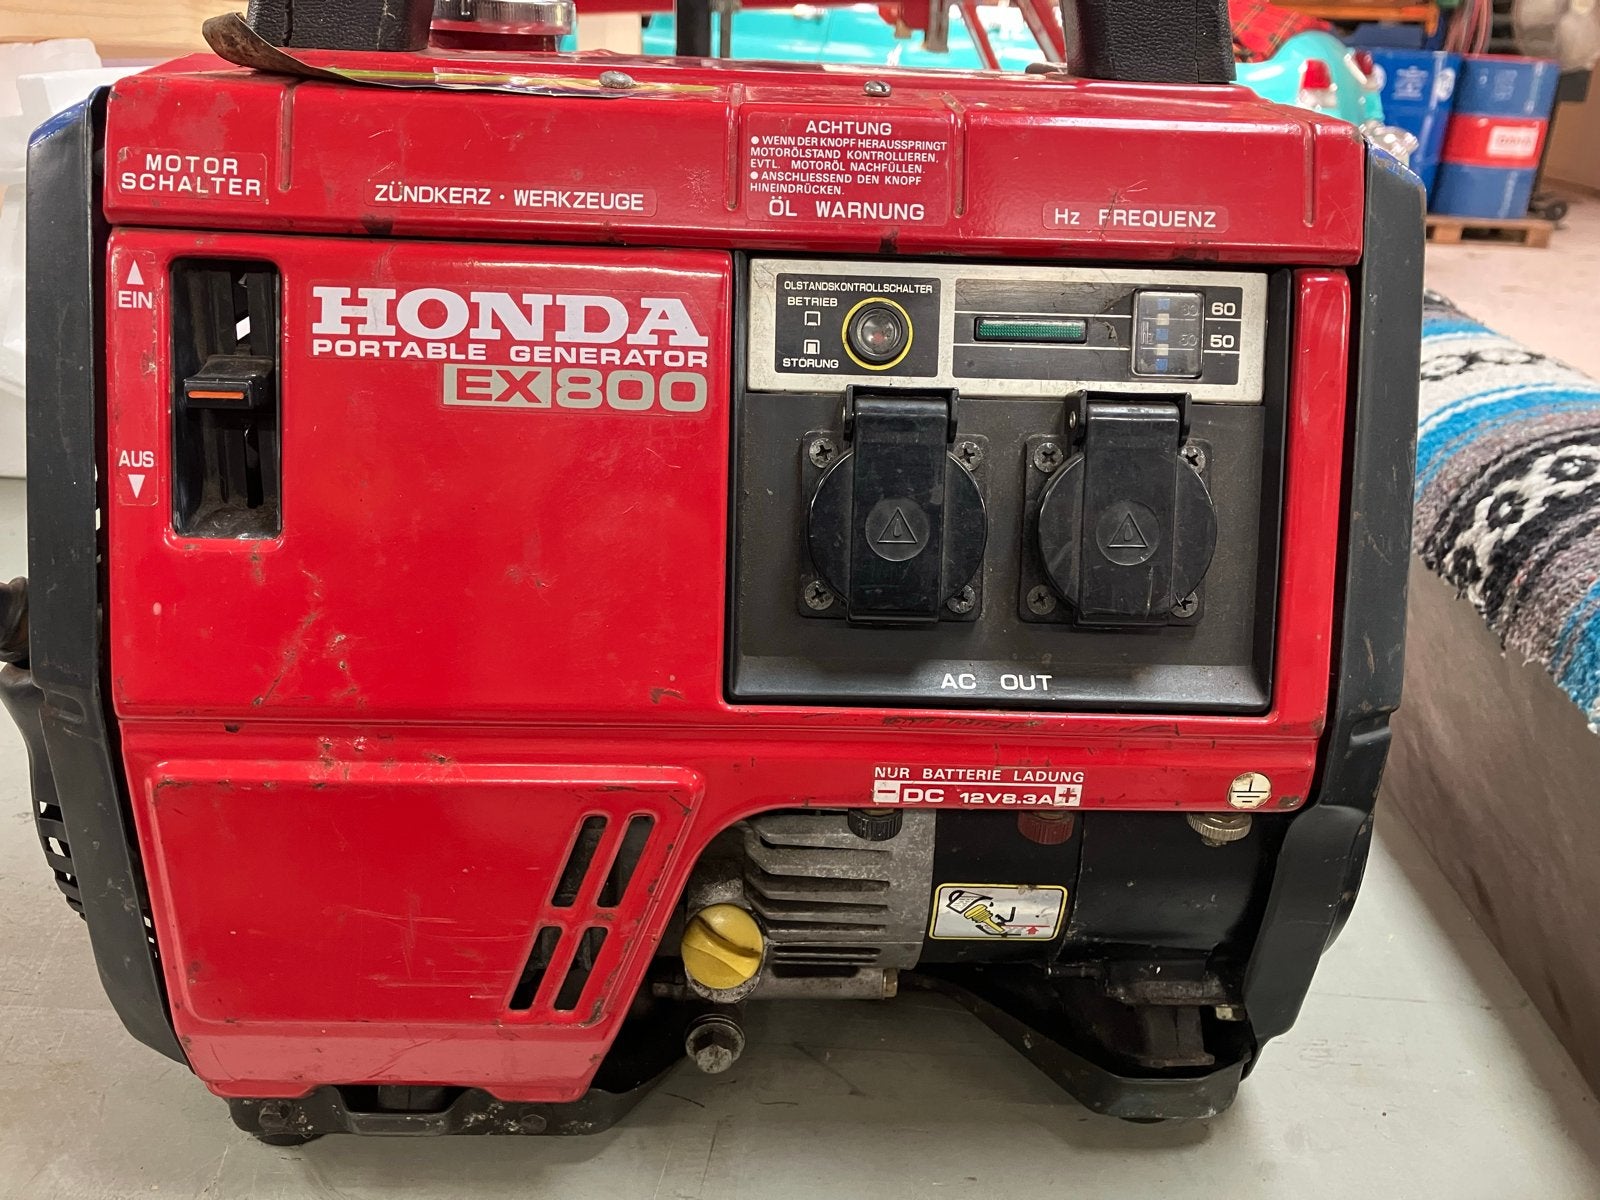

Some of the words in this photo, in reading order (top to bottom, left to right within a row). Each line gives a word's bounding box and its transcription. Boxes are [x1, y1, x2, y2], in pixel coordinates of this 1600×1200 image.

[806, 120, 892, 136] ACHTUNG
[762, 136, 796, 146] WENN
[798, 137, 818, 146] DER
[820, 138, 856, 148] KNOPF
[858, 138, 947, 151] HERAUSSPRINGT
[750, 146, 840, 159] MOTORÖLSTAND
[146, 154, 238, 175] MOTOR
[750, 159, 780, 168] EVTL.
[791, 159, 846, 171] MOTORÖL
[850, 162, 926, 174] NACHFÜLLEN.
[122, 172, 260, 196] SCHALTER
[761, 172, 852, 184] ANSCHLIESSEND
[858, 174, 879, 184] DEN
[884, 176, 922, 186] KNOPF
[374, 181, 492, 205] ZÜNDKERZ
[514, 189, 644, 210] WERKZEUGE
[750, 183, 845, 195] HINEINDRÜCKEN.
[768, 196, 798, 216] ÖL
[816, 200, 925, 220] WARNUNG
[1054, 208, 1080, 224] Hz
[1098, 209, 1216, 228] FREQUENZ
[118, 290, 153, 308] EIN
[788, 296, 838, 306] BETRIEB
[312, 286, 709, 347] HONDA
[1212, 302, 1236, 316] 60
[1210, 334, 1234, 348] 50
[312, 339, 486, 361] PORTABLE
[509, 345, 708, 368] GENERATOR
[118, 450, 154, 468] AUS
[940, 673, 976, 690] AC
[1000, 674, 1052, 690] OUT
[874, 766, 910, 779] NUR
[922, 768, 1001, 781] BATTERIE
[1014, 770, 1084, 782] LADUNG
[903, 788, 944, 803] DC
[960, 792, 1054, 805] 12V8.3A
